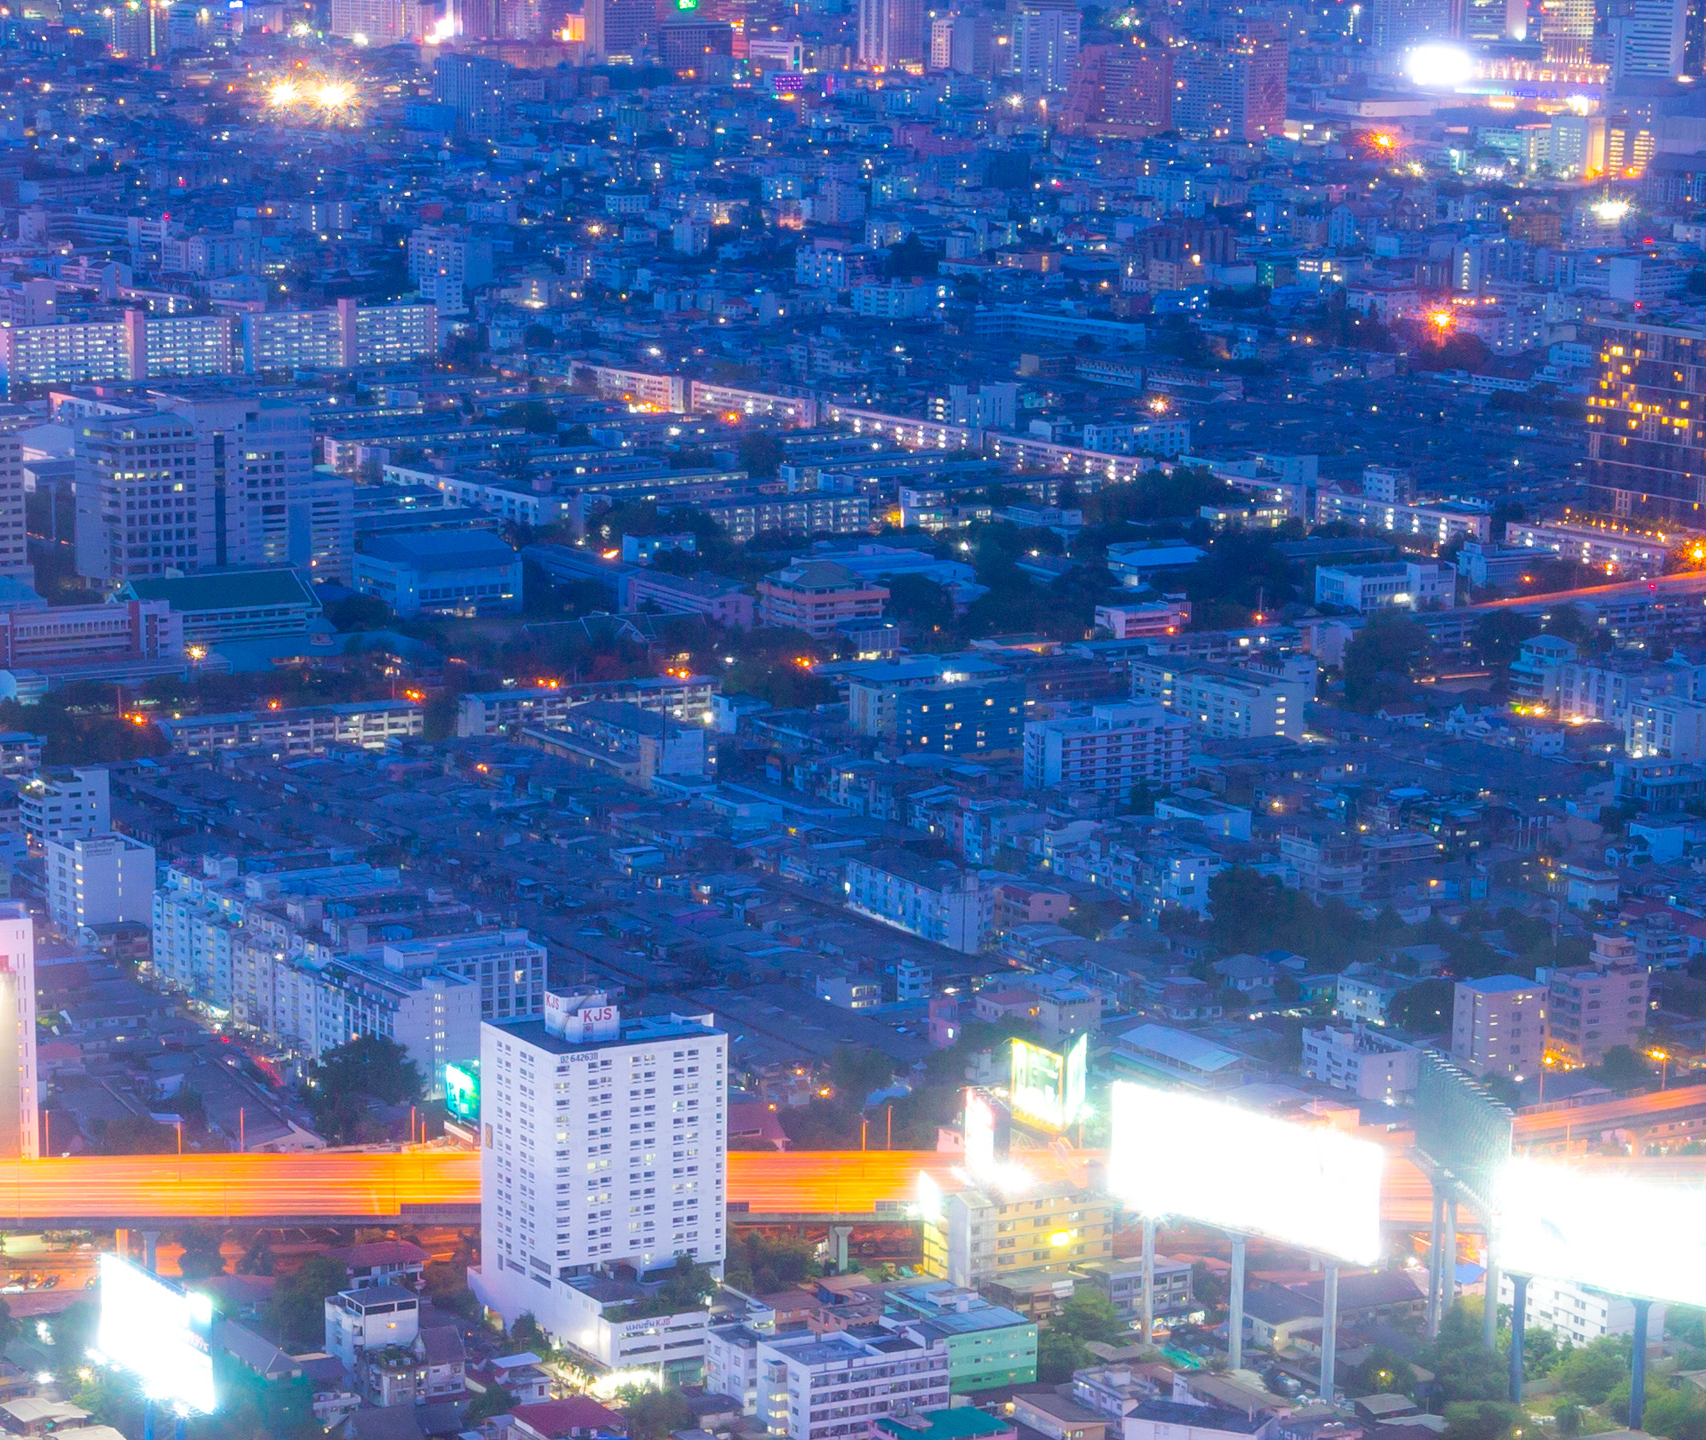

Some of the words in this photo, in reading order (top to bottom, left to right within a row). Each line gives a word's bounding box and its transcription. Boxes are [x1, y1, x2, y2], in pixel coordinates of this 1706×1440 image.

[545, 992, 560, 1011] KJS
[583, 1007, 613, 1023] KJS
[655, 1317, 671, 1327] KJS
